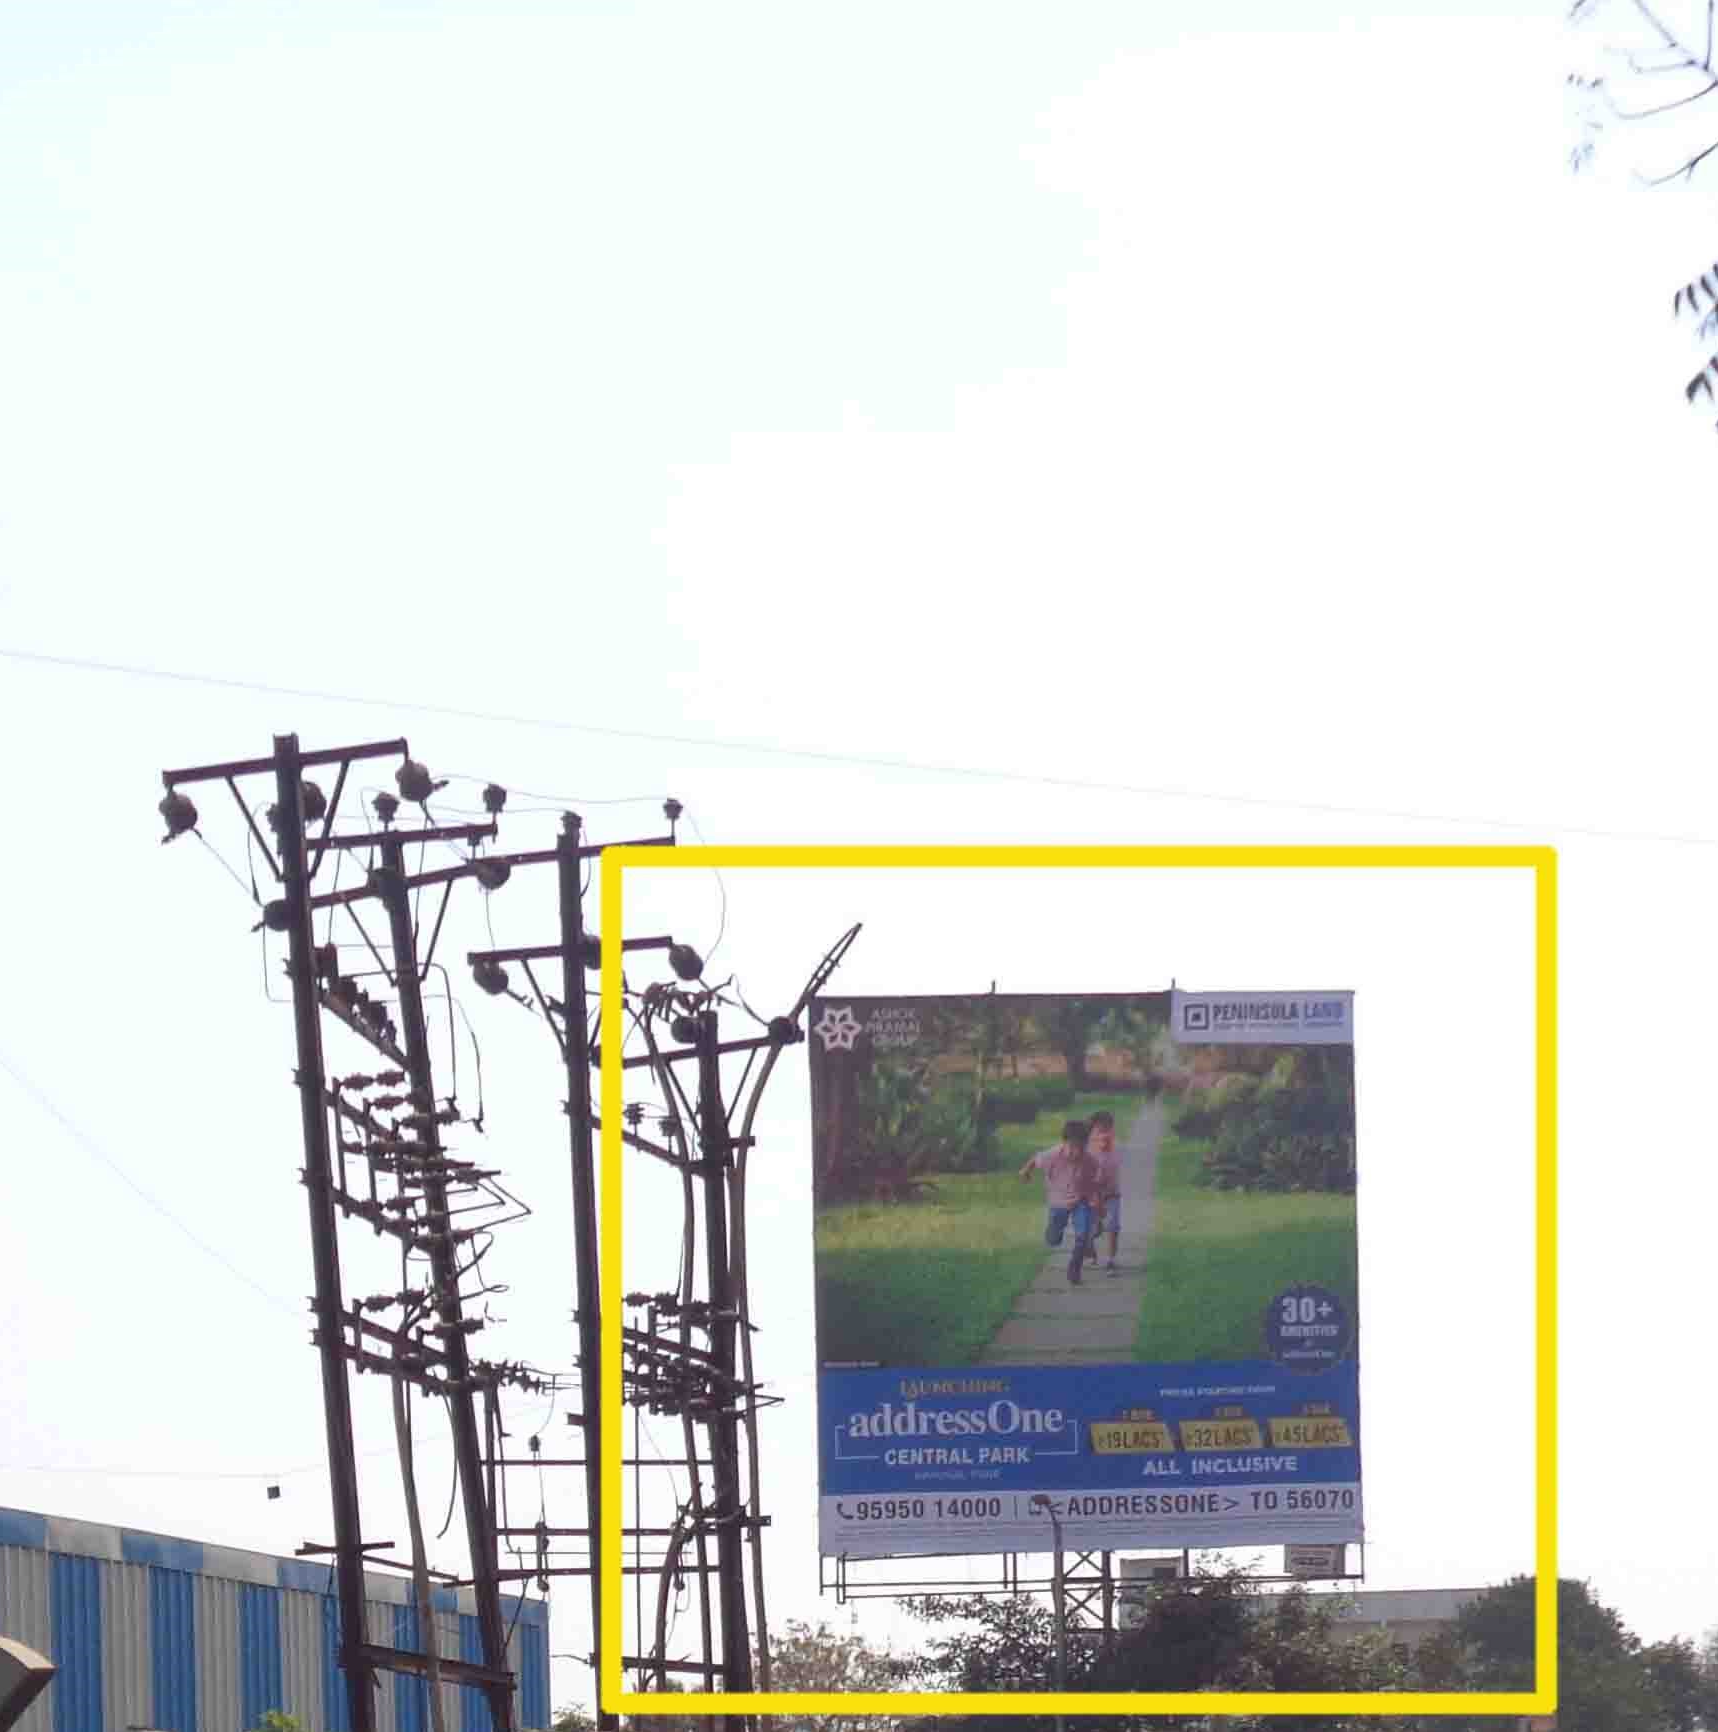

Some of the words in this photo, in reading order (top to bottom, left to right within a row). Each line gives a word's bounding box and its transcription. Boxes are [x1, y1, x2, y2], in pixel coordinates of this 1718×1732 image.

[1213, 1002, 1299, 1020] PENINSULA
[1281, 1296, 1333, 1323] 30+
[848, 1400, 1064, 1438] addressOne
[884, 1448, 973, 1465] CENTRAL
[978, 1446, 1031, 1464] PARK
[1143, 1460, 1181, 1476] ALL
[1191, 1455, 1299, 1475] INCLUSIVE
[856, 1500, 924, 1521] 95950
[934, 1498, 1002, 1518] 14000
[1250, 1490, 1278, 1511] TO
[1287, 1488, 1355, 1510] 56070
